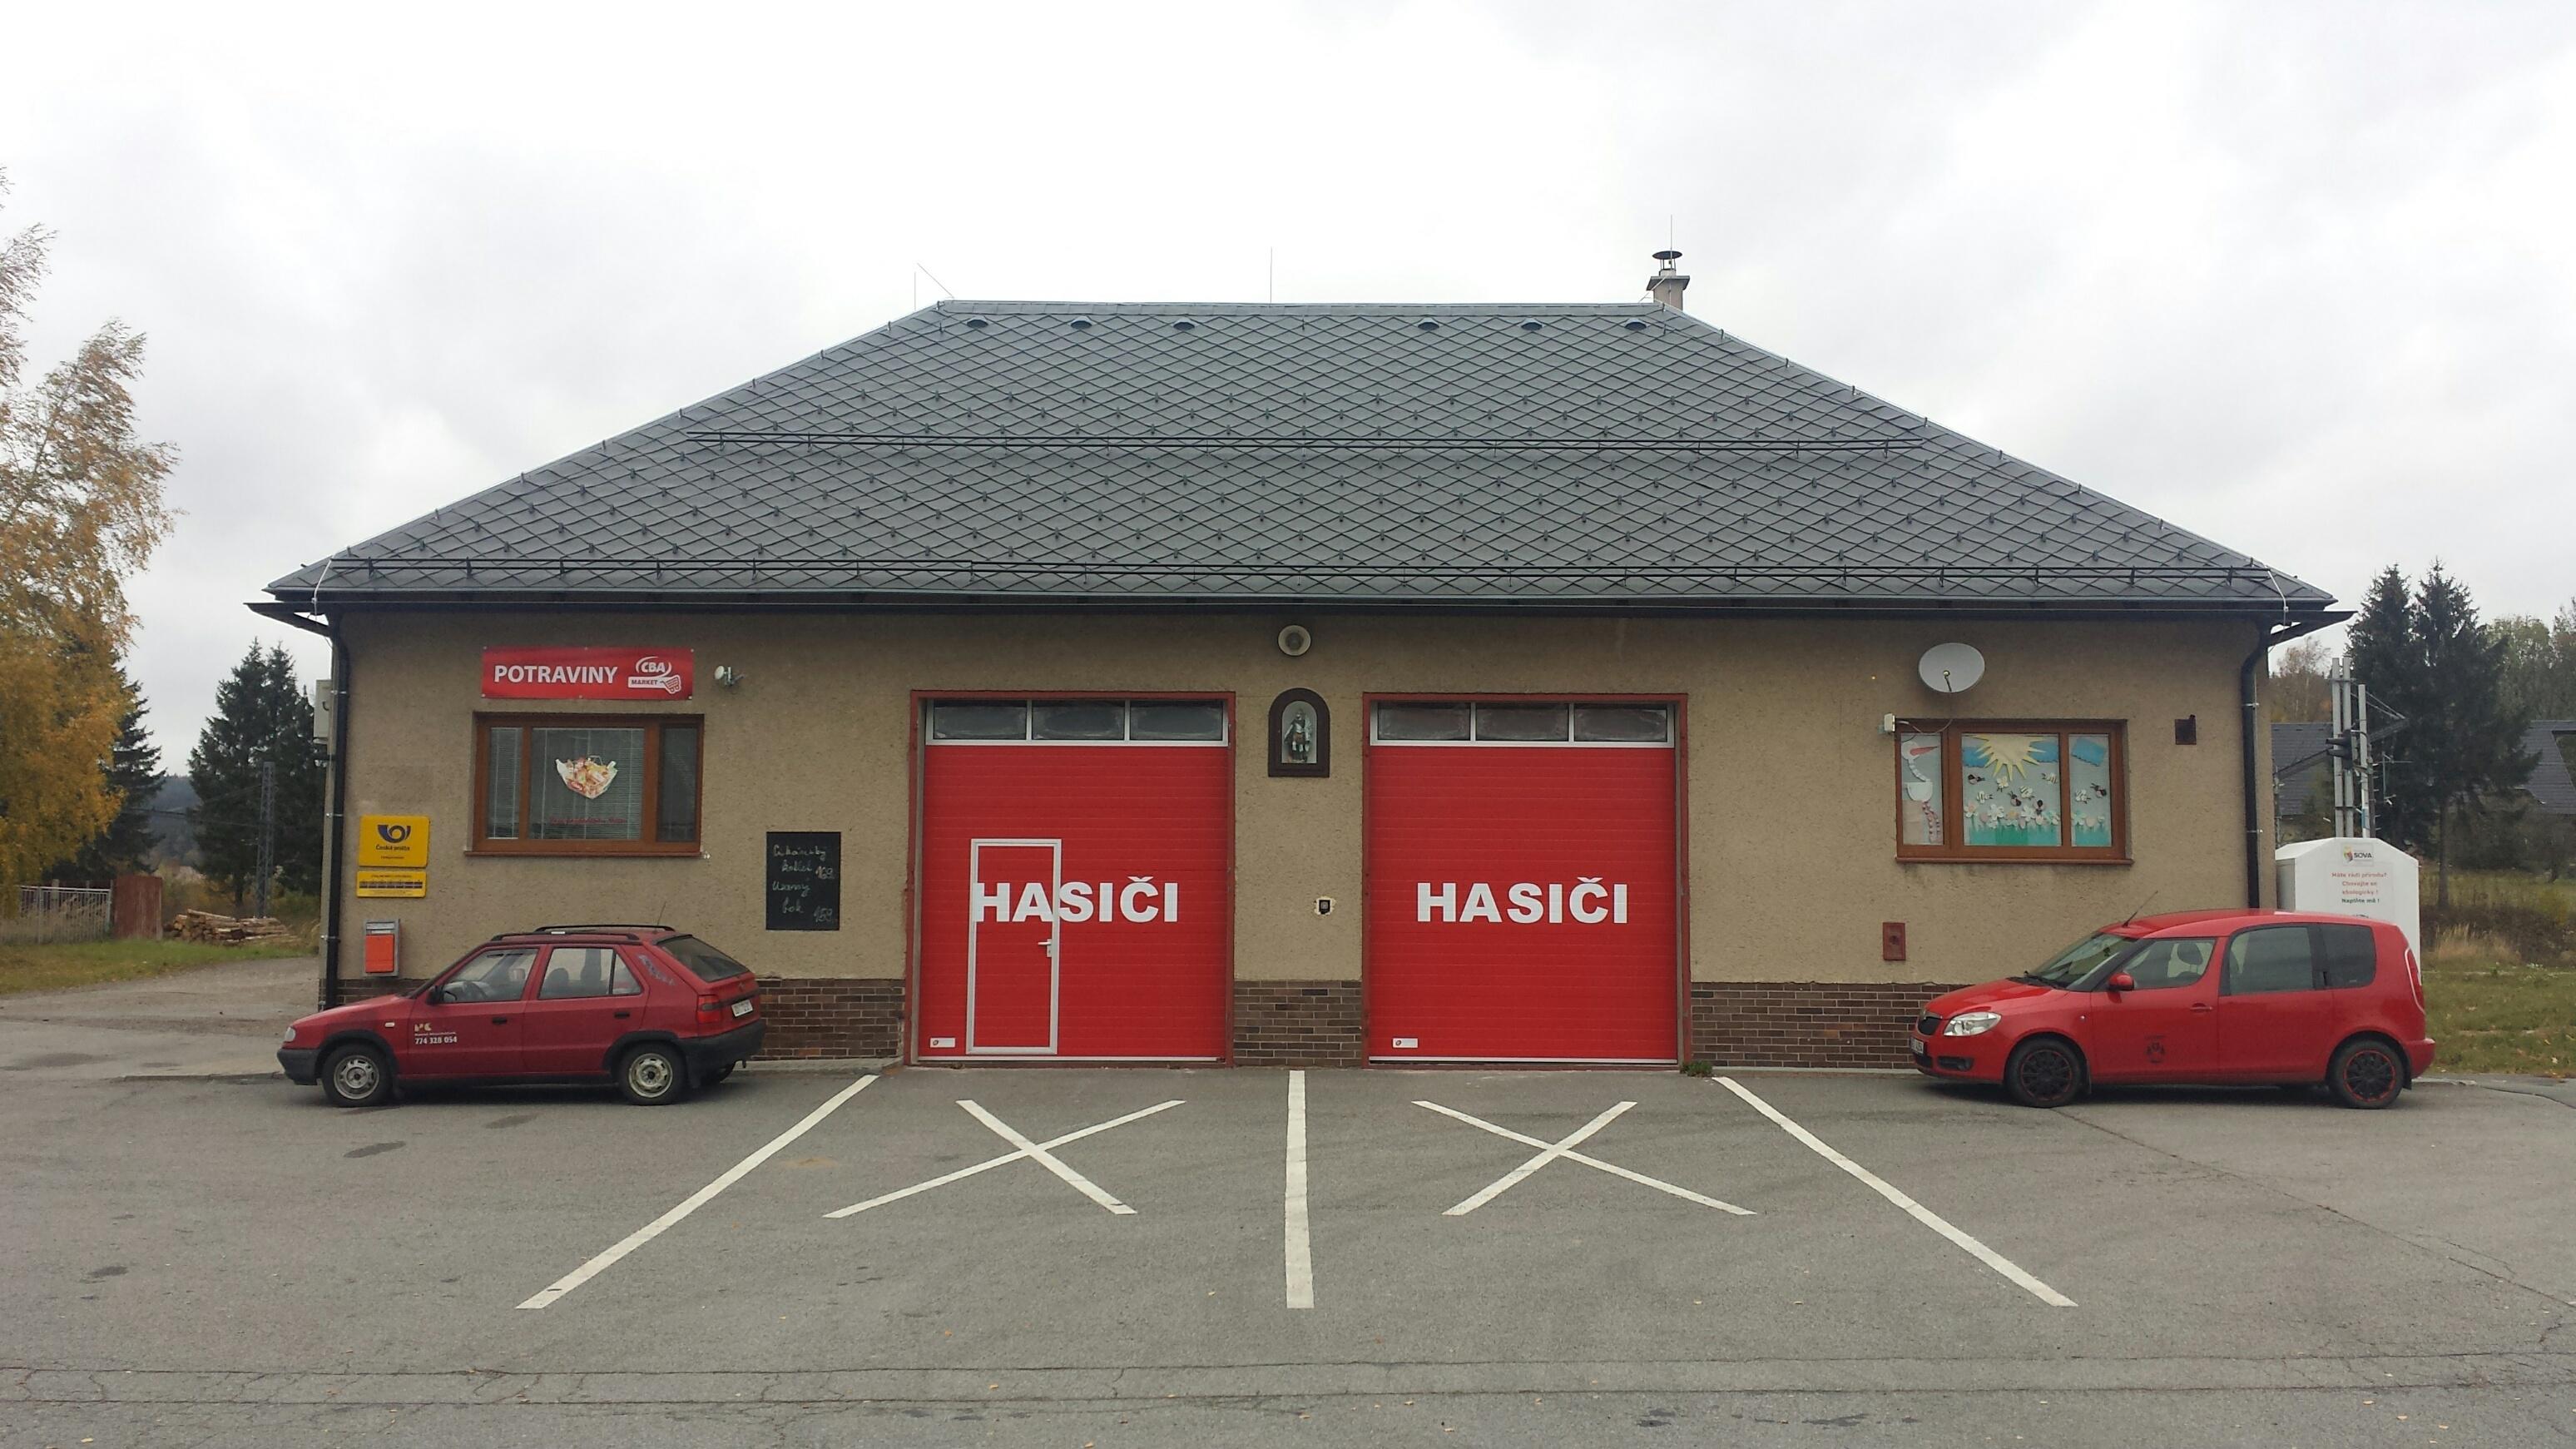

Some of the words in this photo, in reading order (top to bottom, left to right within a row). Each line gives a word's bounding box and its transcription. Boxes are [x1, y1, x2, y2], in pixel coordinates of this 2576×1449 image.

[493, 664, 618, 684] POTRAVINY
[640, 661, 666, 673] CBA
[974, 876, 1180, 924] HASIČI
[1416, 876, 1628, 925] HASIČI
